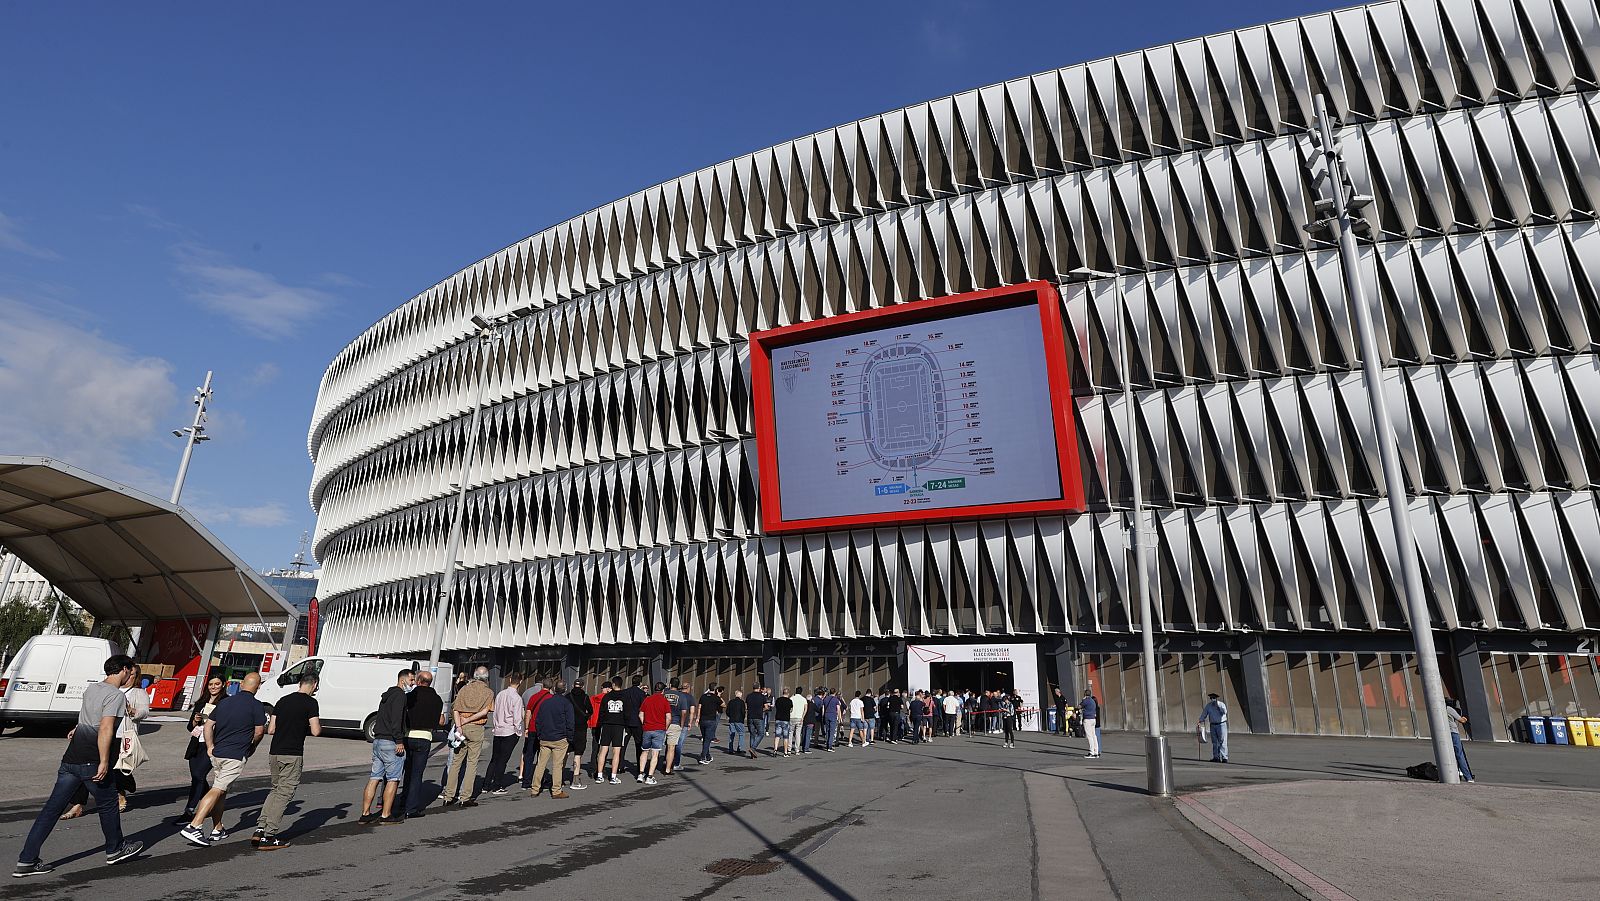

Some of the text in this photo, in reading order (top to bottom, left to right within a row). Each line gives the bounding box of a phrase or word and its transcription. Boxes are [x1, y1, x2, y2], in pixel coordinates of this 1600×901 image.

[931, 481, 947, 489] 7-24
[833, 642, 849, 655] 23
[1577, 638, 1599, 653] 21
